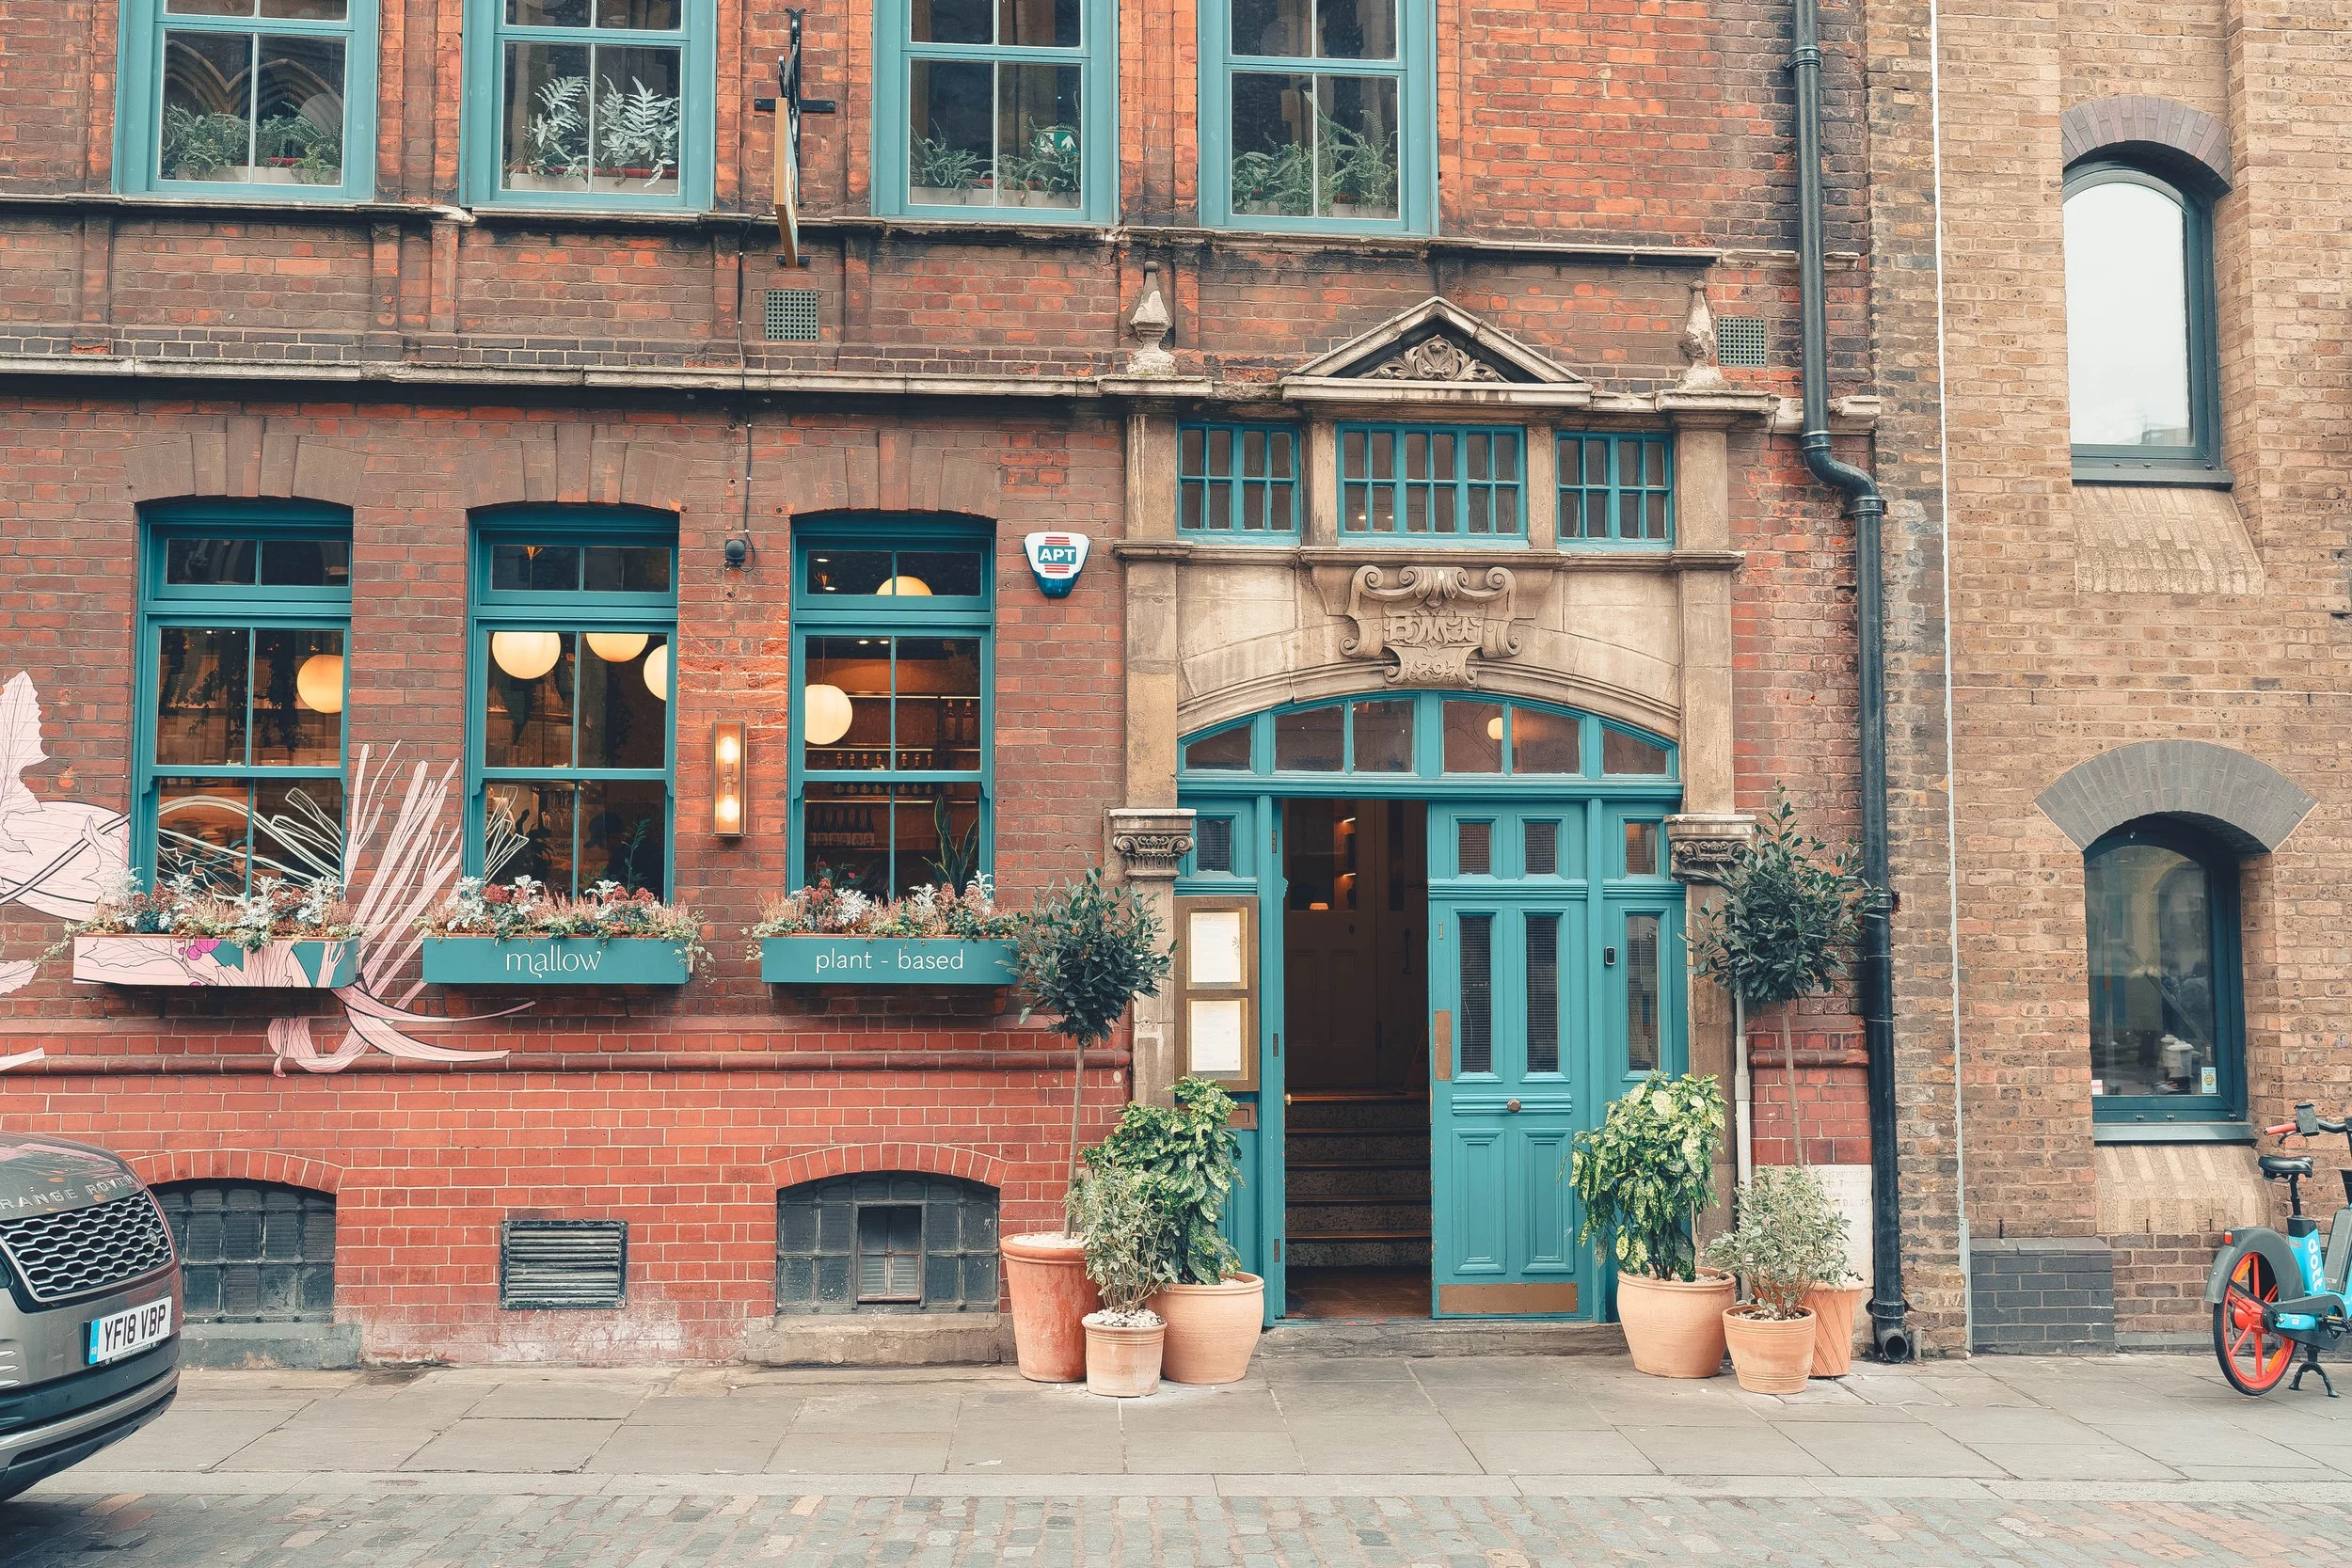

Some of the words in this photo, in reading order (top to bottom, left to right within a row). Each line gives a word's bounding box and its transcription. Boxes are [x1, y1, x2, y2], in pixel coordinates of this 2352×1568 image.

[1039, 547, 1075, 562] APT
[504, 944, 602, 979] mallow
[816, 947, 872, 974] plant
[898, 947, 964, 971] based
[0, 1188, 78, 1210] RANGE
[85, 1174, 135, 1196] ROVER
[2309, 1239, 2324, 1291] dott
[104, 1313, 137, 1353] YF18
[141, 1304, 167, 1339] VBP
